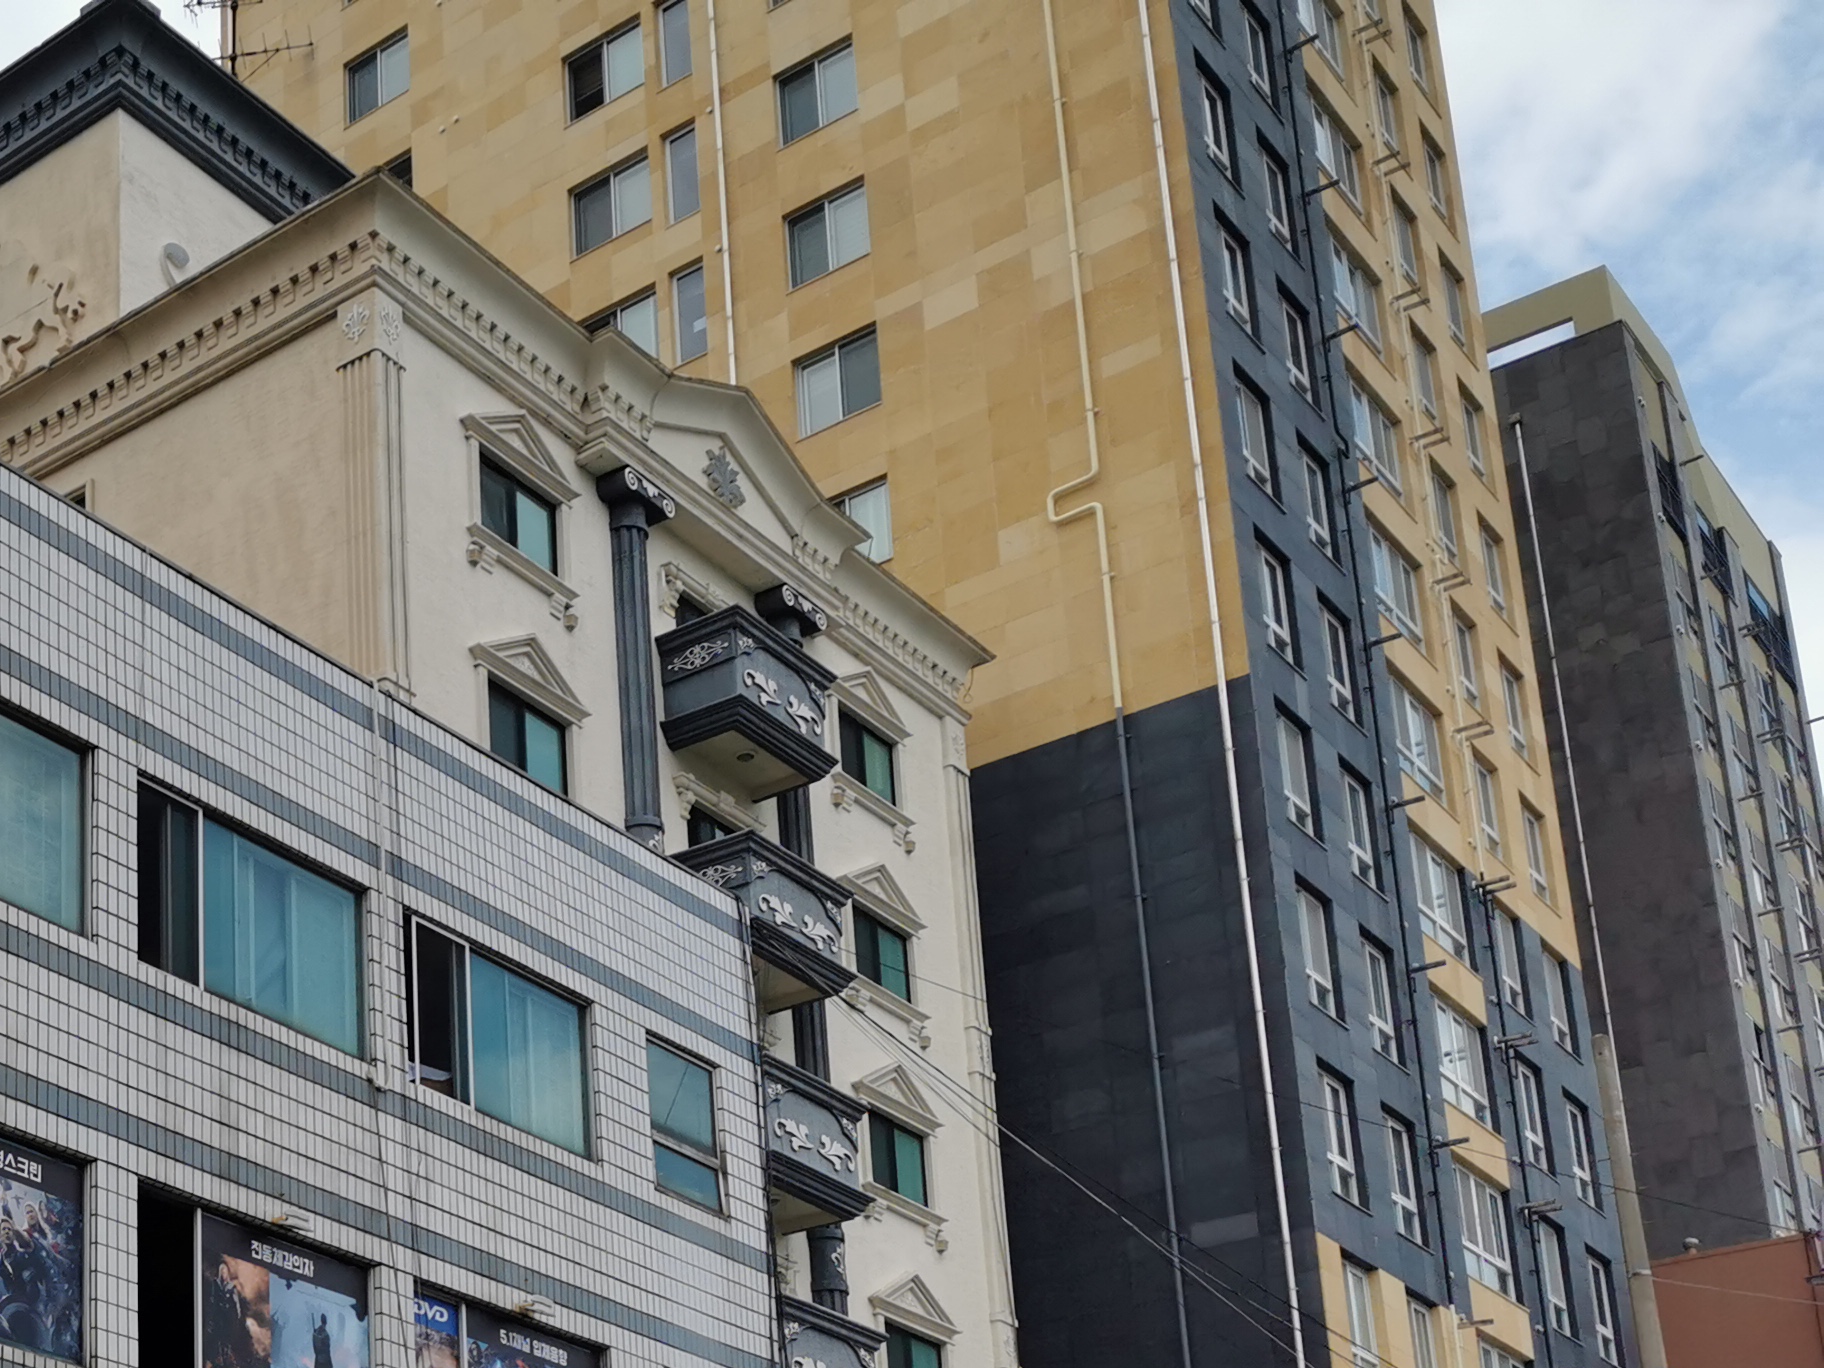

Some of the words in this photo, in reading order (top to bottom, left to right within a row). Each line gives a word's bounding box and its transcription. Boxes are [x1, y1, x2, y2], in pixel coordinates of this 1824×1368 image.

[250, 1239, 315, 1278] 진동체감의자
[414, 1300, 449, 1323] DVD
[499, 1328, 531, 1354] 5.1채널
[532, 1339, 569, 1367] 입체음향
